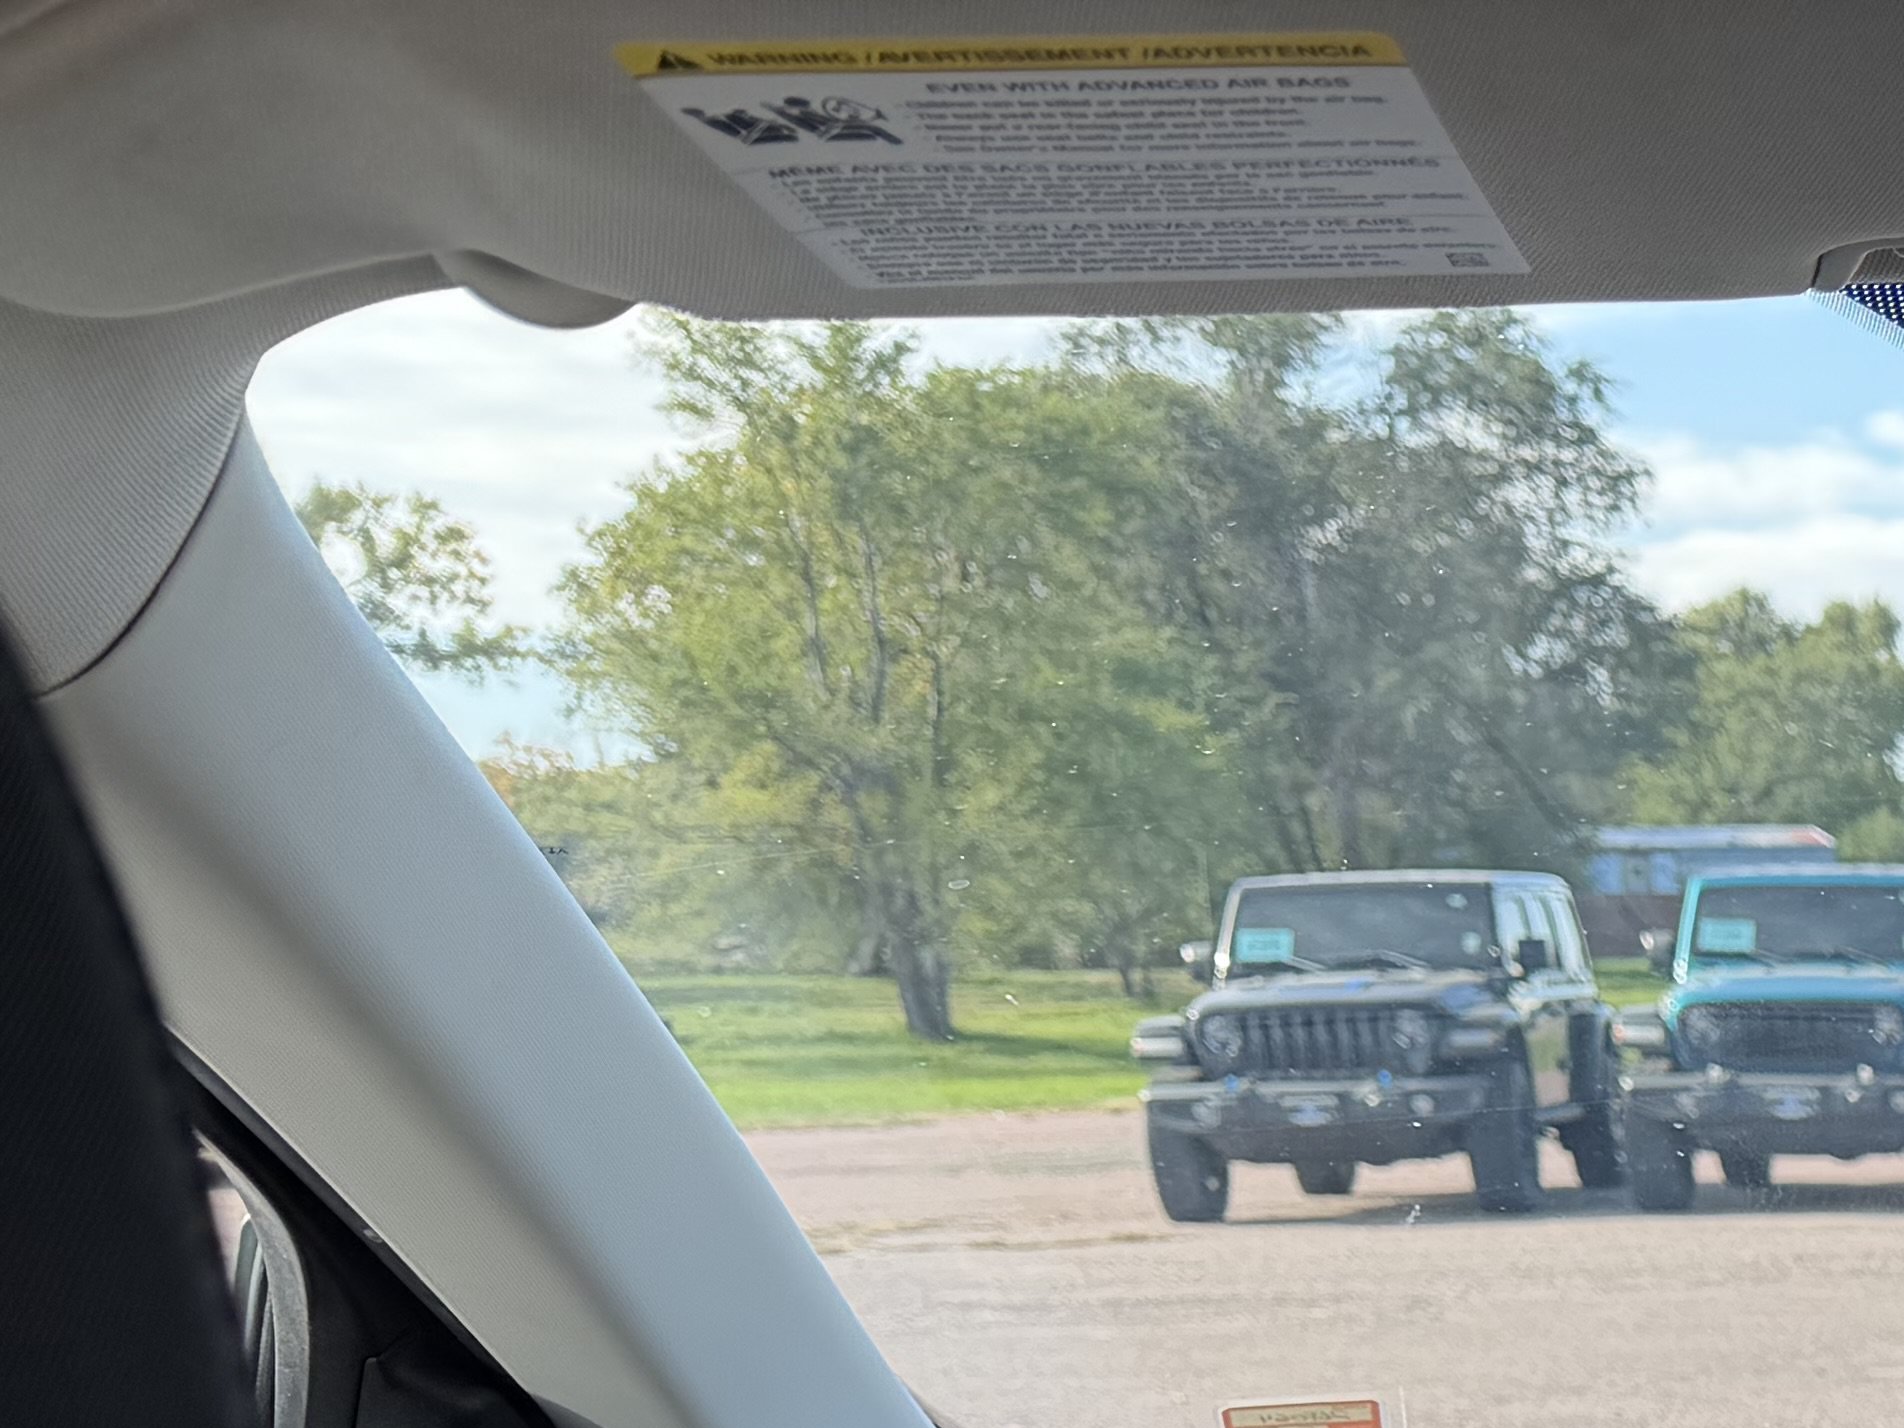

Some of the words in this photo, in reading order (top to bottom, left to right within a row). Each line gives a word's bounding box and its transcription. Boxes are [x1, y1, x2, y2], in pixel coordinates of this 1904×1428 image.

[925, 82, 997, 93] EVEN
[1003, 81, 1070, 92] WITH
[1078, 78, 1220, 91] ADVANCED
[1227, 77, 1268, 89] AIR
[1277, 76, 1351, 89] BAGS
